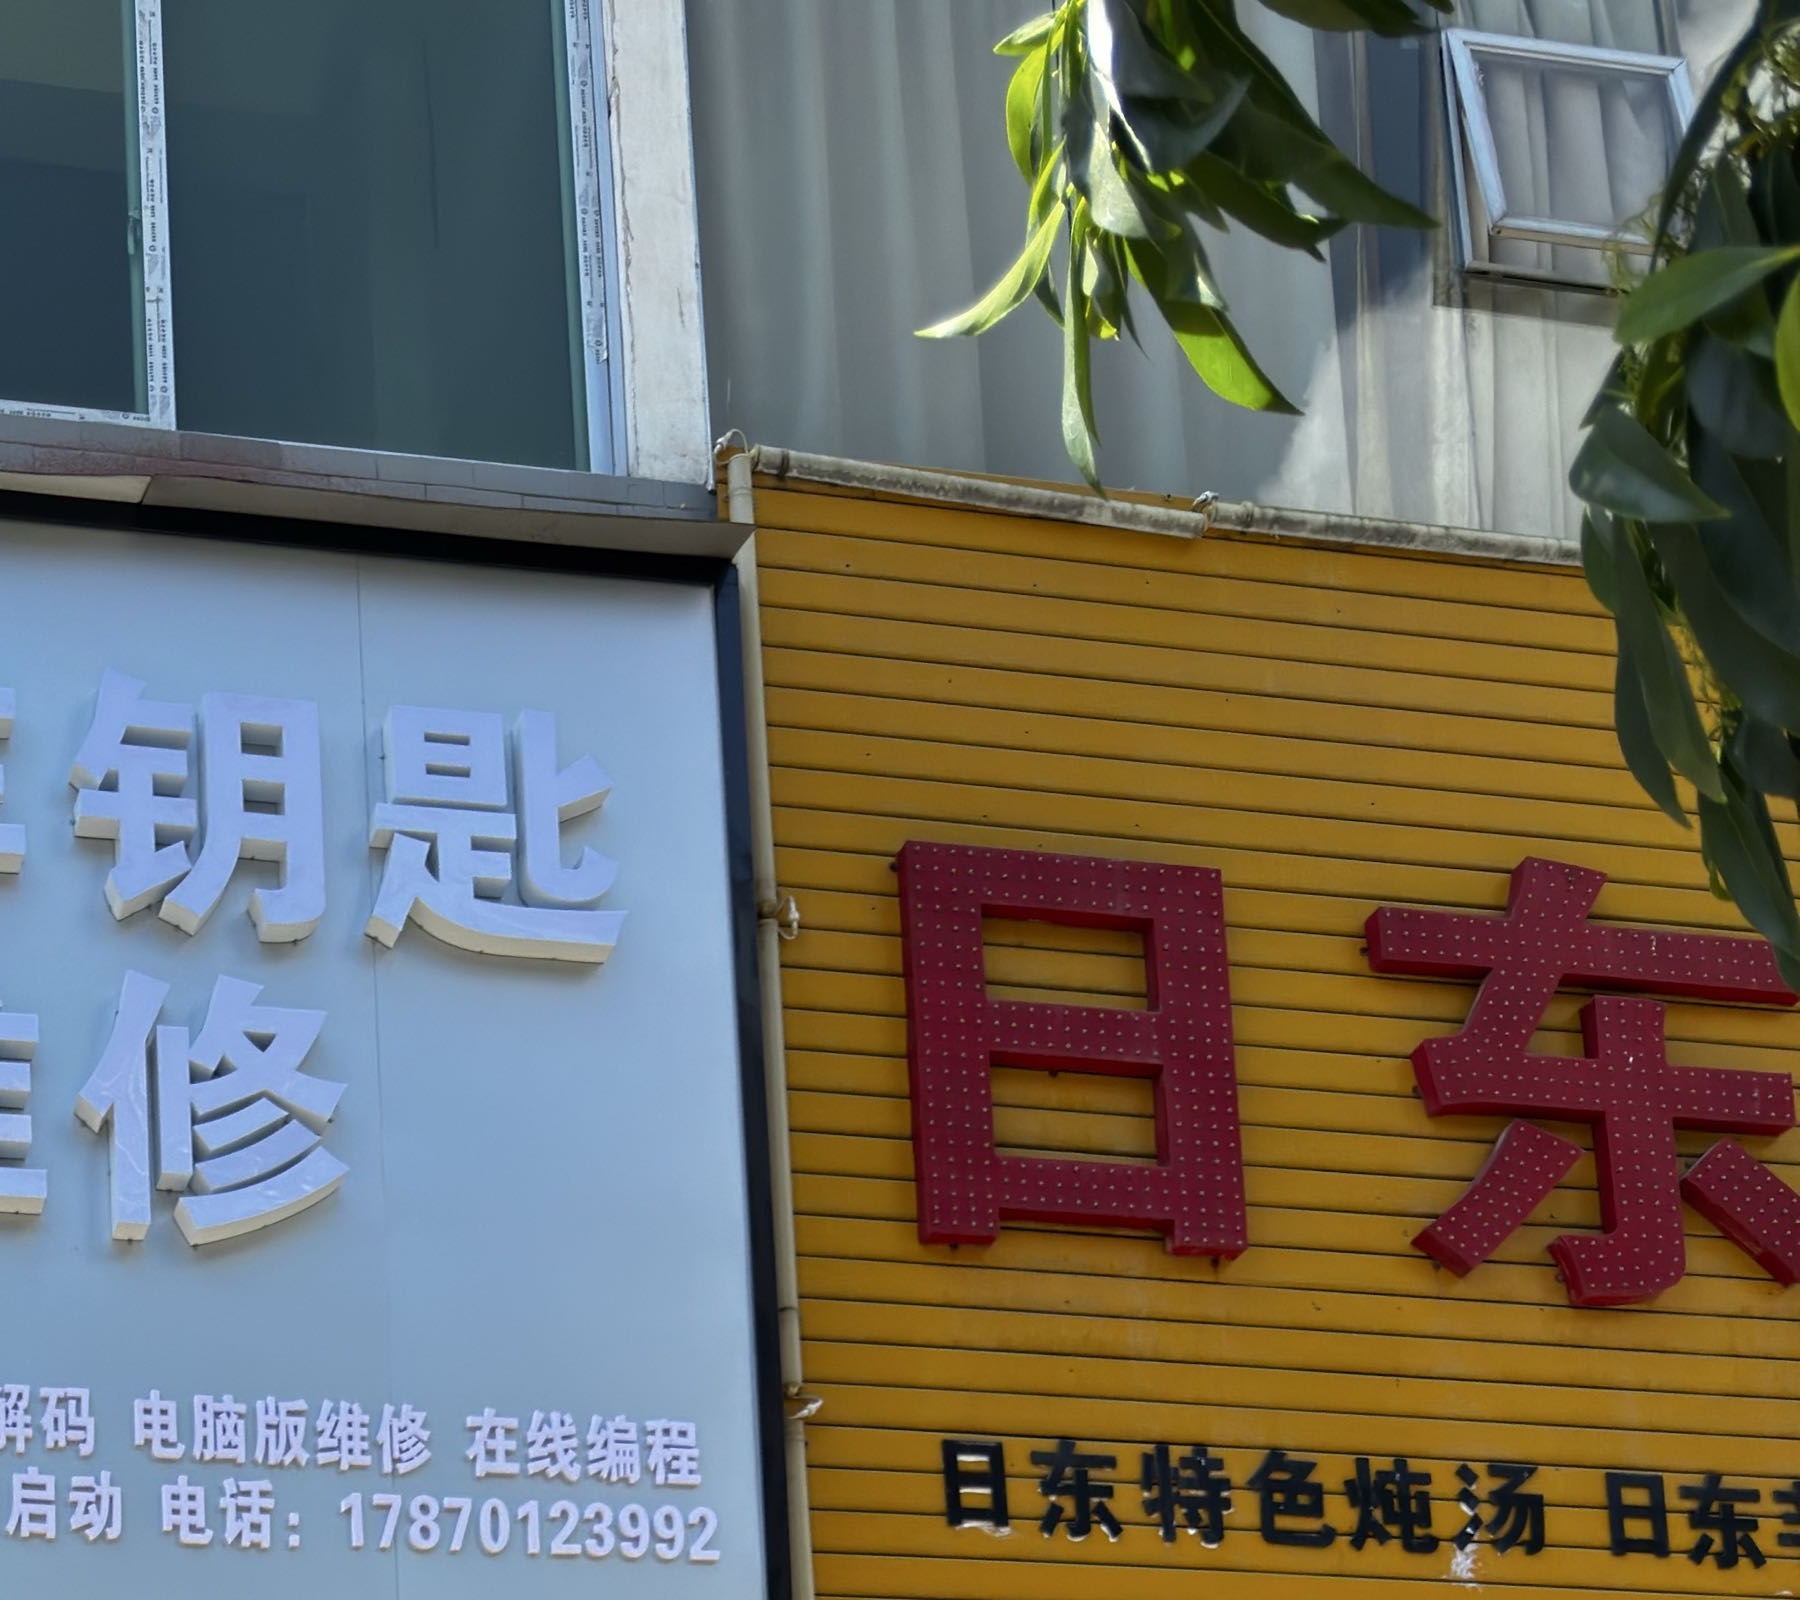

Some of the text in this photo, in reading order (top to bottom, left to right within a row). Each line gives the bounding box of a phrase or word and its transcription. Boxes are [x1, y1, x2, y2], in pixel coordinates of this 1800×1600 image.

[895, 840, 1800, 1307] 日东
[134, 1389, 432, 1476] 电脑版维修
[465, 1406, 702, 1487] 在线编程
[340, 1492, 721, 1564] 17870123992
[941, 1438, 1548, 1556] 日东特色炖汤
